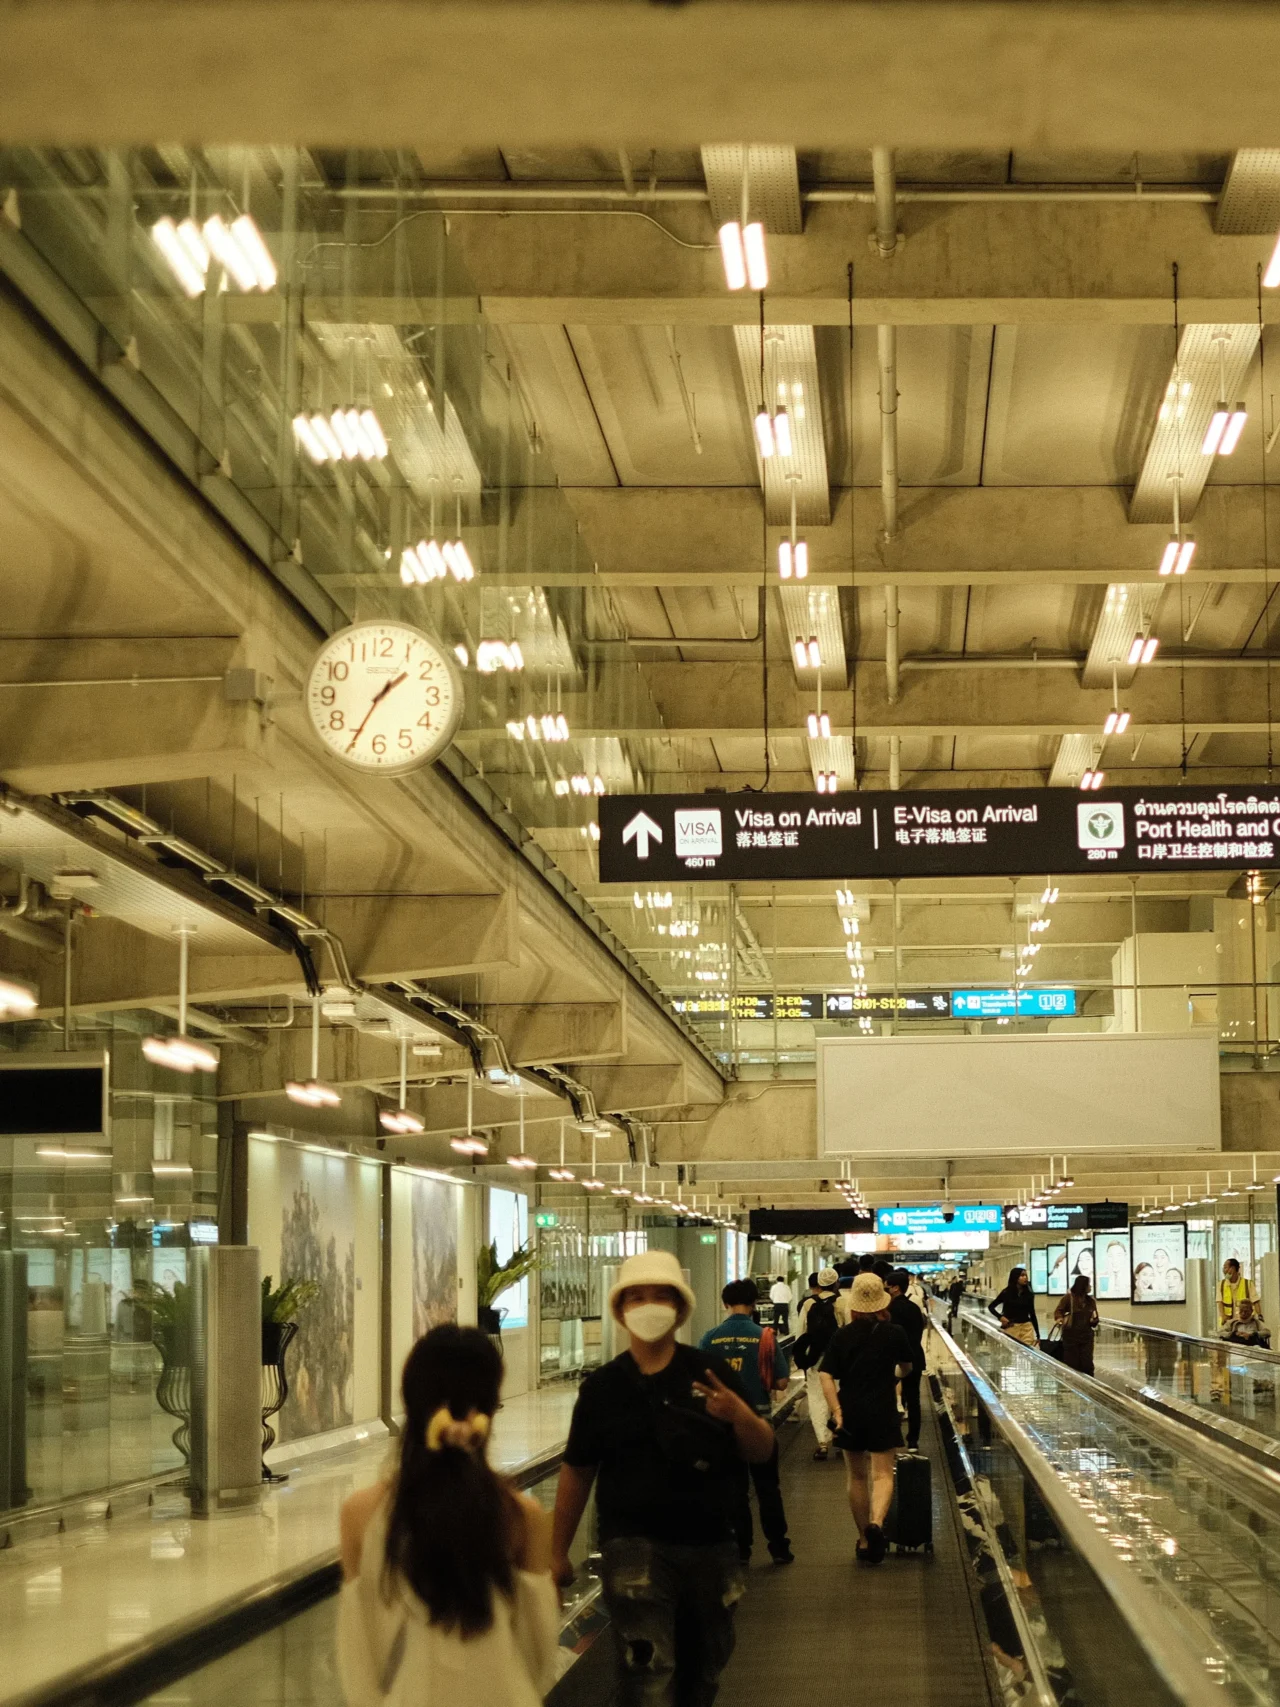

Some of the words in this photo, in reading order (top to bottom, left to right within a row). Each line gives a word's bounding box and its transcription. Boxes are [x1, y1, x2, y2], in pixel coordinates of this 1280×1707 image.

[351, 642, 366, 662] 11
[373, 637, 394, 658] 12
[328, 661, 349, 682] 10
[419, 660, 434, 681] 2
[321, 686, 336, 706] 9
[426, 686, 440, 706] 3
[330, 710, 345, 731] 8
[416, 711, 432, 731] 4
[372, 734, 387, 755] 6
[398, 729, 413, 749] 5
[735, 808, 775, 828] Visa
[778, 812, 801, 827] on
[805, 807, 862, 827] Arrival
[893, 806, 952, 825] E-Visa
[955, 808, 978, 824] on
[982, 804, 1038, 823] Arrival
[679, 822, 717, 836] VISA
[736, 830, 799, 848] 落地签证
[895, 827, 988, 845] 电子落地签证
[1136, 820, 1173, 839] Port
[1176, 819, 1232, 838] Health
[1236, 819, 1269, 837] and
[684, 858, 704, 868] 460
[705, 858, 715, 868] m
[1107, 850, 1118, 860] m
